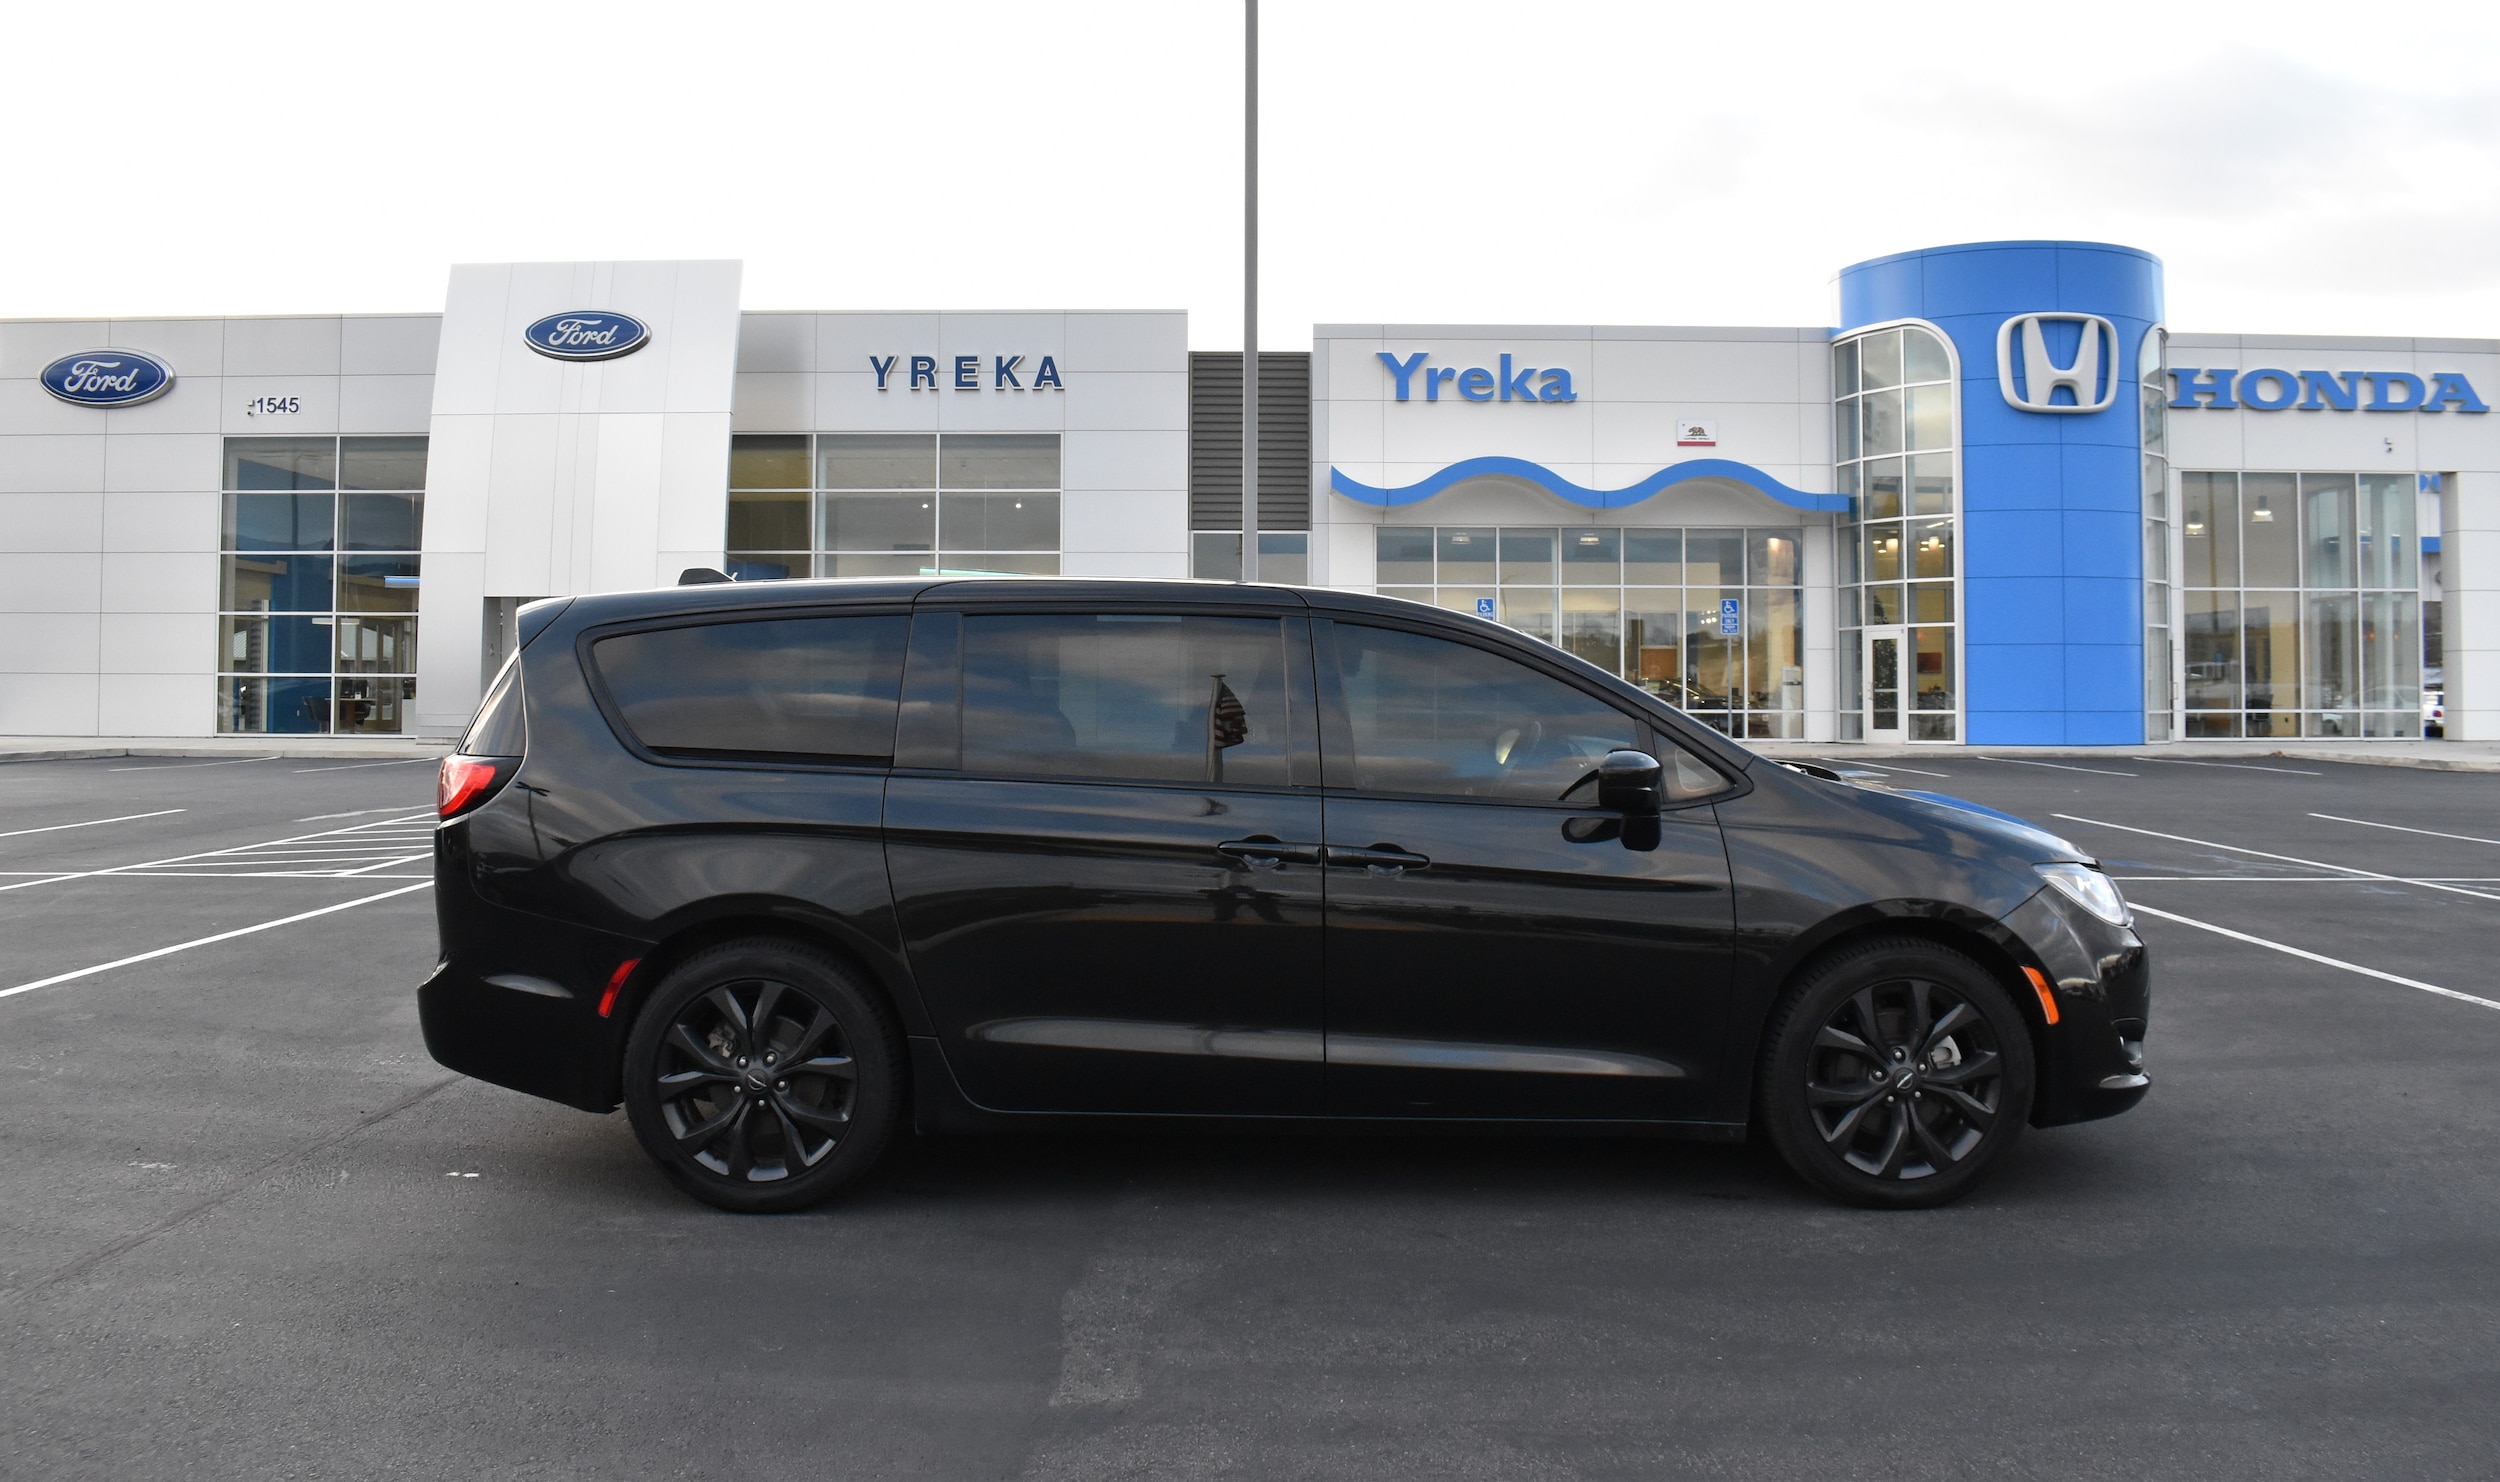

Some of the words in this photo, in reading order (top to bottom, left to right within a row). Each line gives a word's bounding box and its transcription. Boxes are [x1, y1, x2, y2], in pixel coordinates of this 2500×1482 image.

[547, 318, 619, 346] Ford
[63, 360, 139, 392] Ford
[869, 354, 1064, 391] YREKA
[1375, 352, 1578, 402] Yreka
[256, 397, 299, 414] 1545
[2168, 368, 2490, 413] HONDA
